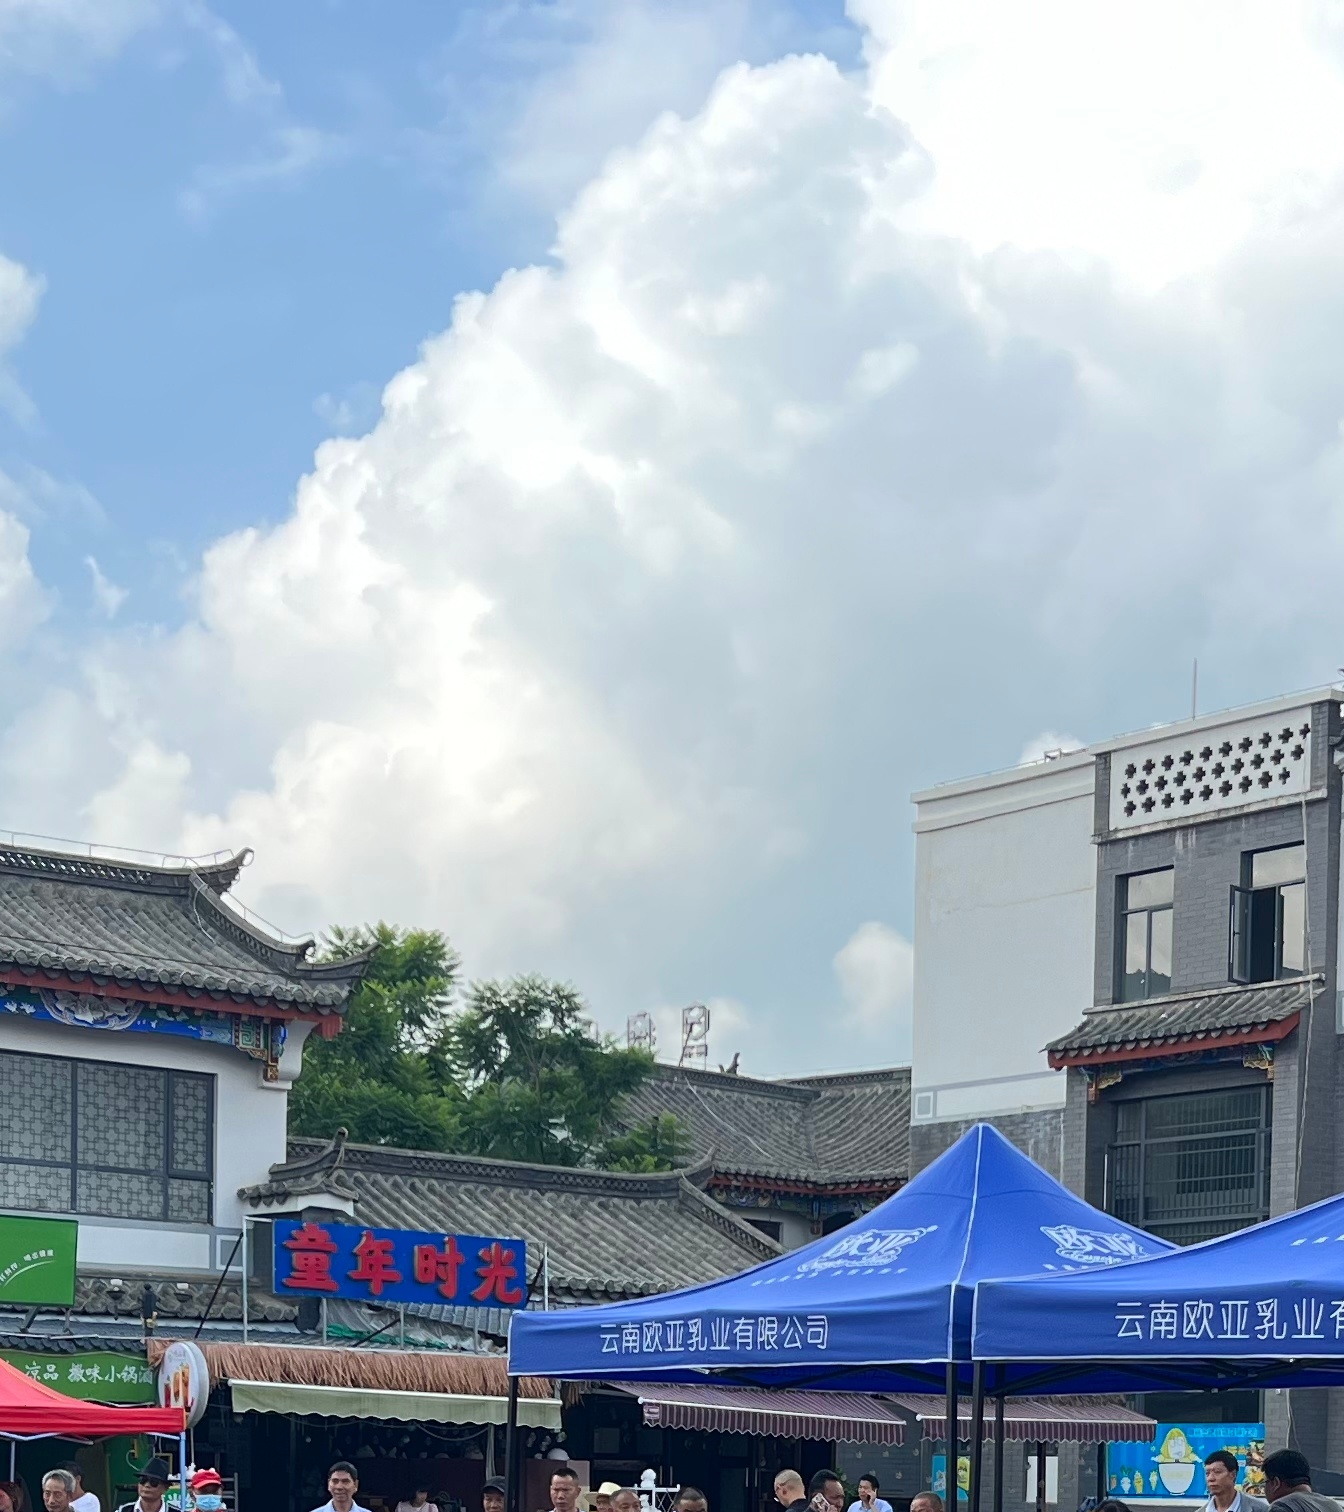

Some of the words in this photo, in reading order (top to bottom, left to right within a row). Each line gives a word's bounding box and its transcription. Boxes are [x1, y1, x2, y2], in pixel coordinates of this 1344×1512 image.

[282, 1223, 523, 1304] 童年时光
[599, 1315, 829, 1354] 云南欧亚乳业有限公司
